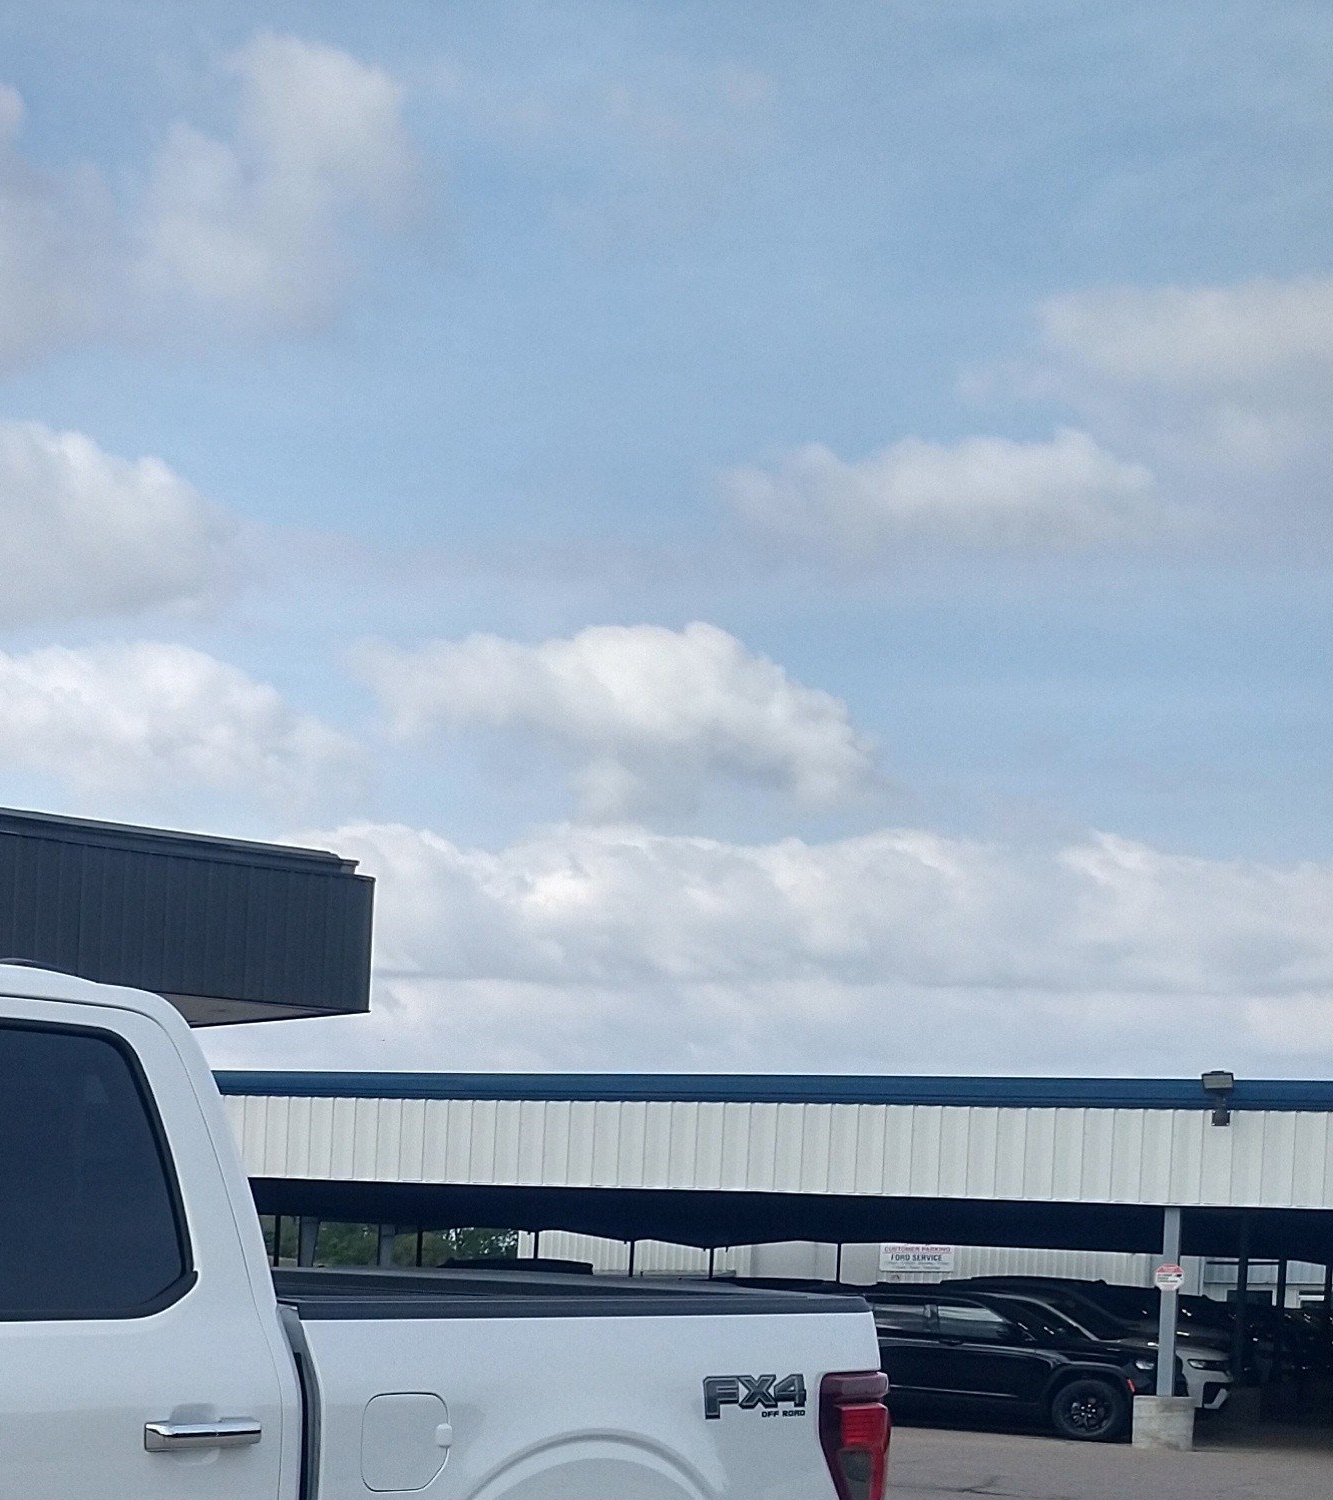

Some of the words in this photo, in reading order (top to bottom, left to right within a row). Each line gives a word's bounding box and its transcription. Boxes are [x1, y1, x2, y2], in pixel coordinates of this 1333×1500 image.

[890, 1253, 911, 1261] FORD
[703, 1374, 807, 1419] FX4
[761, 1409, 780, 1418] OFF
[782, 1409, 806, 1417] ROAD
